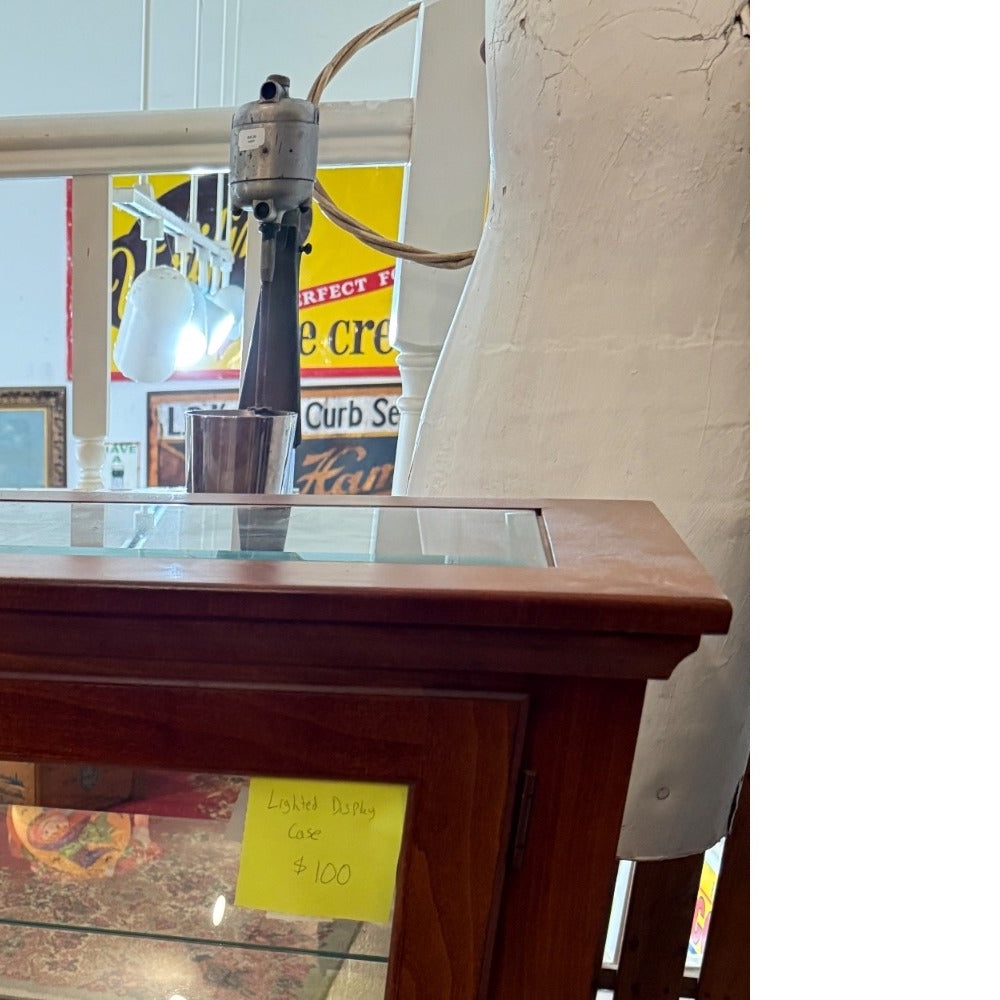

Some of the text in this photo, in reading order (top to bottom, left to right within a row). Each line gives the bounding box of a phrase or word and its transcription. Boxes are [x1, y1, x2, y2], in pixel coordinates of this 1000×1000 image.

[306, 401, 363, 430] Curb
[267, 789, 318, 815] Lighted
[288, 822, 322, 841] Case
